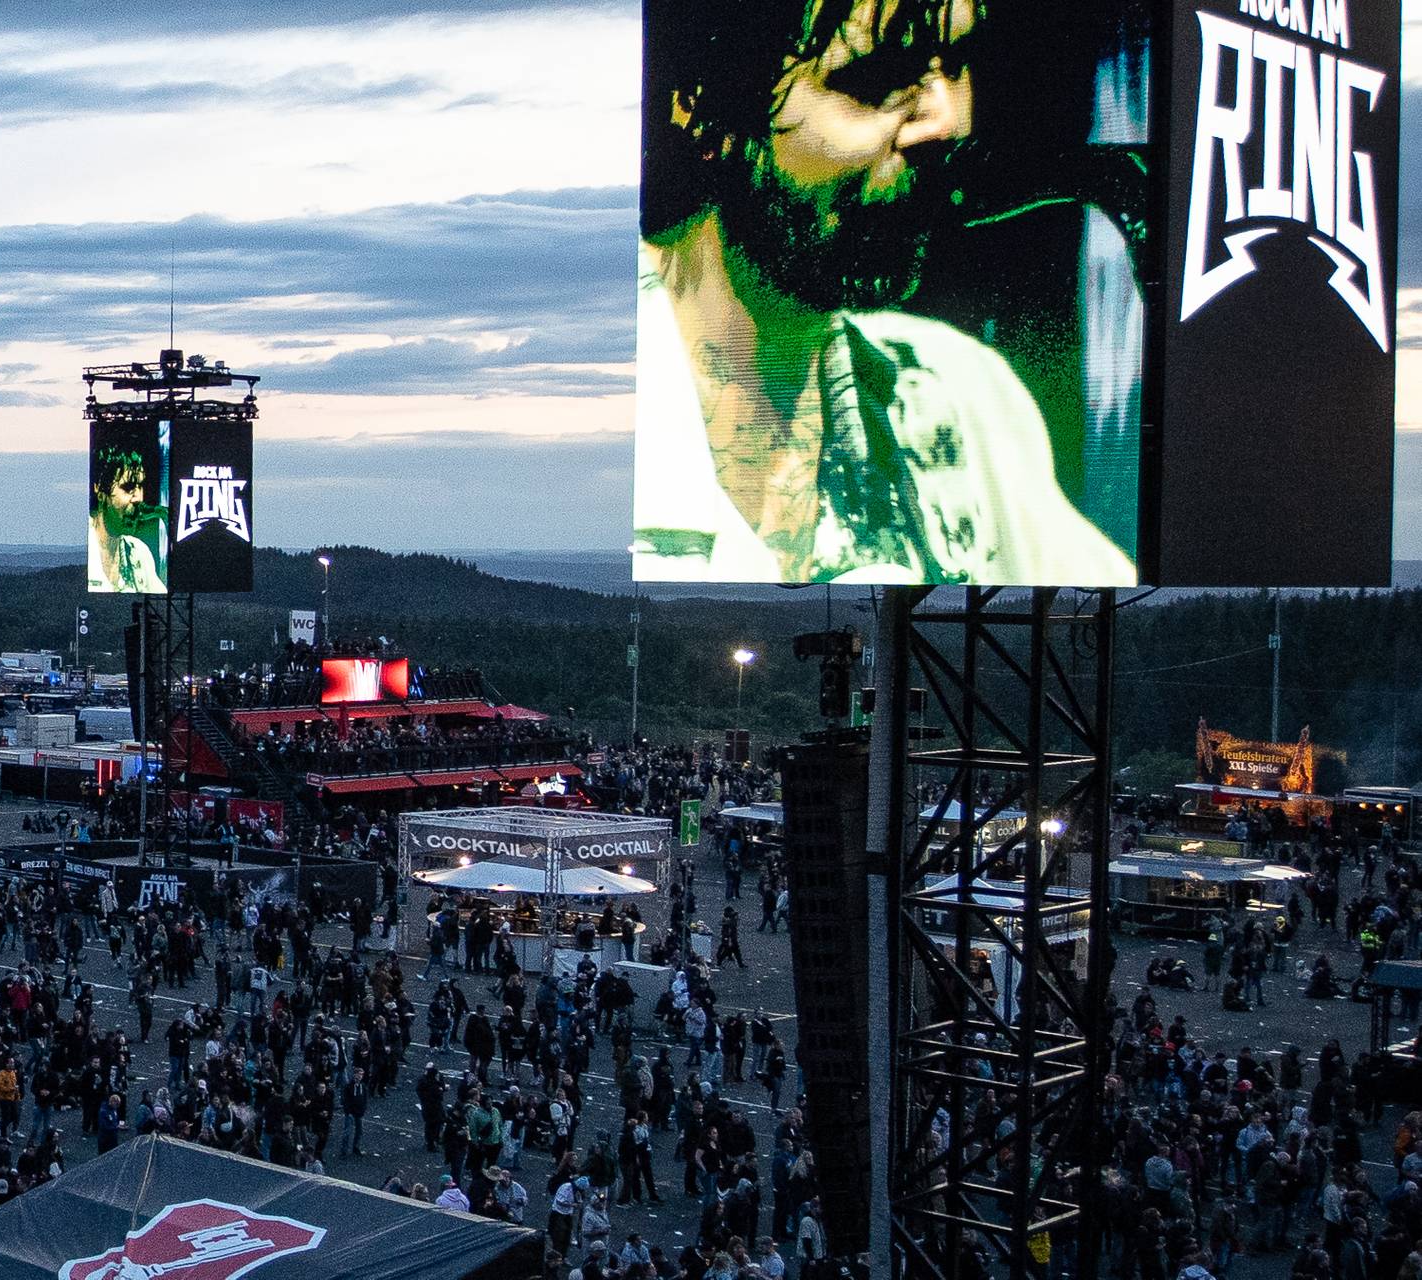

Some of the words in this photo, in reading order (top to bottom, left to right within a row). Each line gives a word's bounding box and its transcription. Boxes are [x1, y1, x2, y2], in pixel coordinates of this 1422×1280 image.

[1180, 10, 1387, 353] RING
[194, 465, 216, 479] ROCK
[218, 466, 233, 480] AM
[177, 479, 250, 542] RING
[292, 619, 315, 629] WC
[1222, 750, 1288, 764] Teufelsbraten
[1229, 761, 1246, 771] XXL
[1247, 762, 1279, 774] Spieße
[427, 835, 527, 858] COCKTAIL
[578, 840, 655, 859] COCKTAIL
[20, 860, 50, 869] BREZEL
